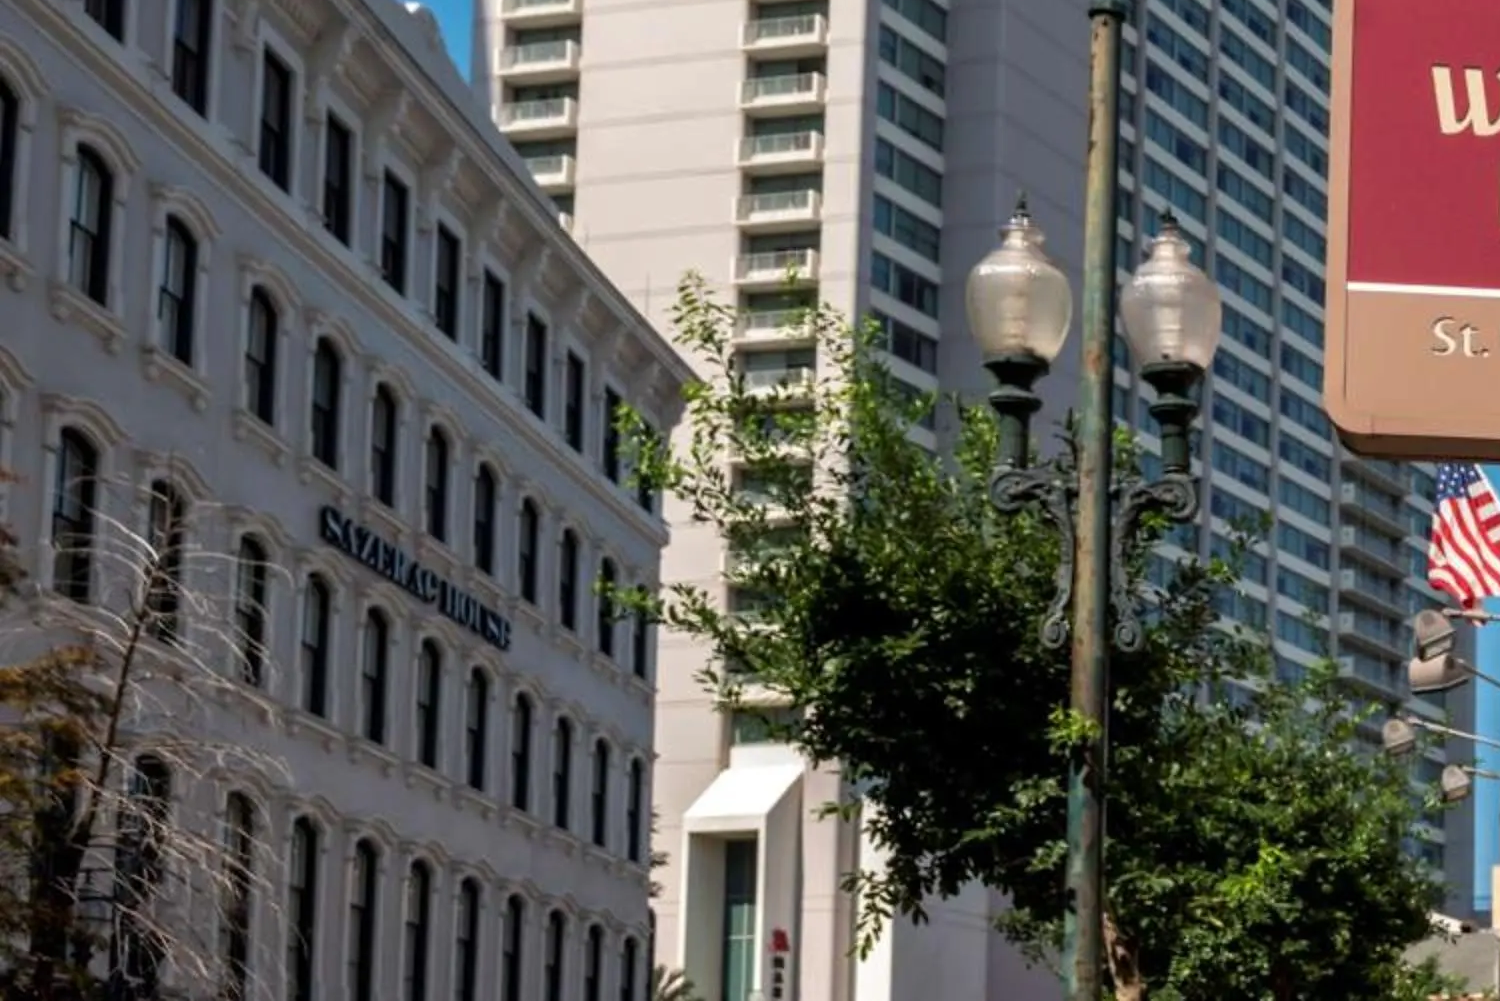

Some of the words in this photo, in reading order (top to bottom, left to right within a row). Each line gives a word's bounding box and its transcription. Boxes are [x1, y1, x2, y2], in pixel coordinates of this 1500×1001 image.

[1431, 316, 1490, 358] St.
[321, 506, 437, 603] SAZERAC
[438, 579, 512, 652] HOUSE
